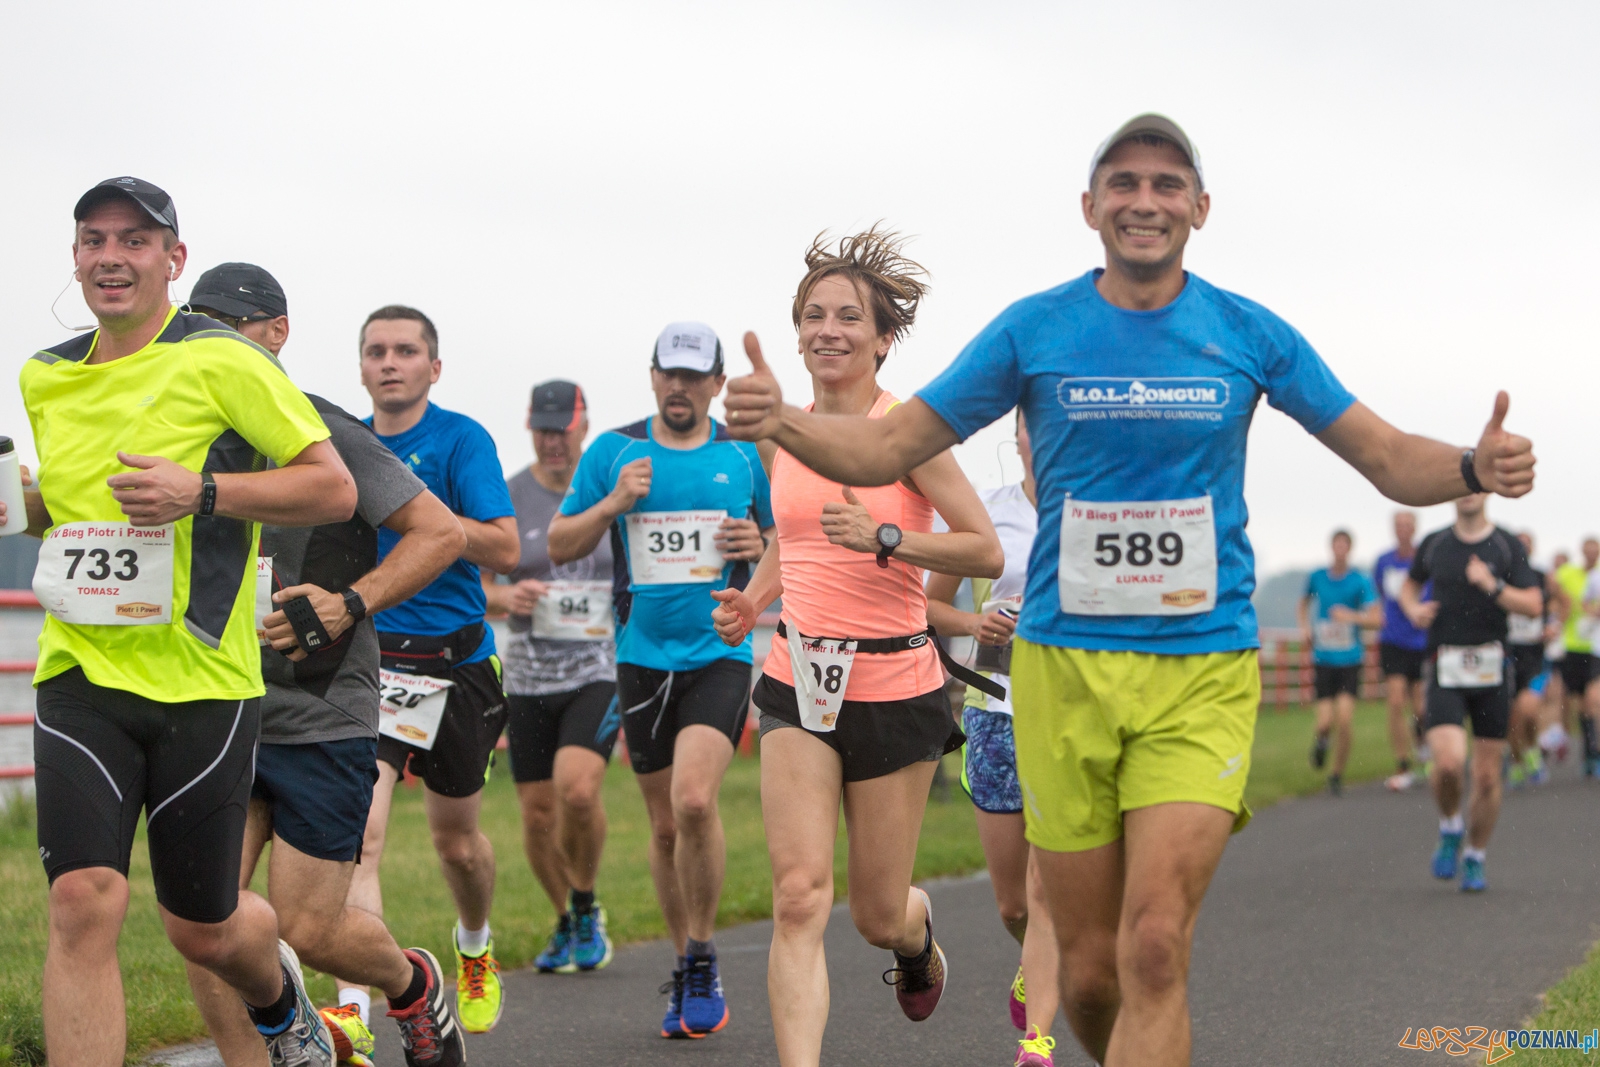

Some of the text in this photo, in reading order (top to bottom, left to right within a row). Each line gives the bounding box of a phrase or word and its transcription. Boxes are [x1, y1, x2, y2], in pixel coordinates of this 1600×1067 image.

[1069, 410, 1106, 421] FABRYKA
[1164, 410, 1223, 421] GUMOWYCH
[643, 516, 663, 525] Bieg
[665, 514, 686, 523] Piotr
[1086, 509, 1117, 523] Bieg
[1122, 508, 1157, 520] Piotr
[62, 528, 84, 539] Bieg
[87, 527, 115, 537] Piotr
[119, 527, 123, 537] i
[127, 528, 166, 539] Paweł
[648, 529, 701, 553] 391
[1094, 531, 1184, 567] 589
[63, 548, 139, 581] 733
[77, 587, 120, 596] TOMASZ
[560, 596, 589, 615] 94
[830, 645, 834, 654] i
[393, 674, 416, 686] Piotr
[815, 698, 827, 706] NA
